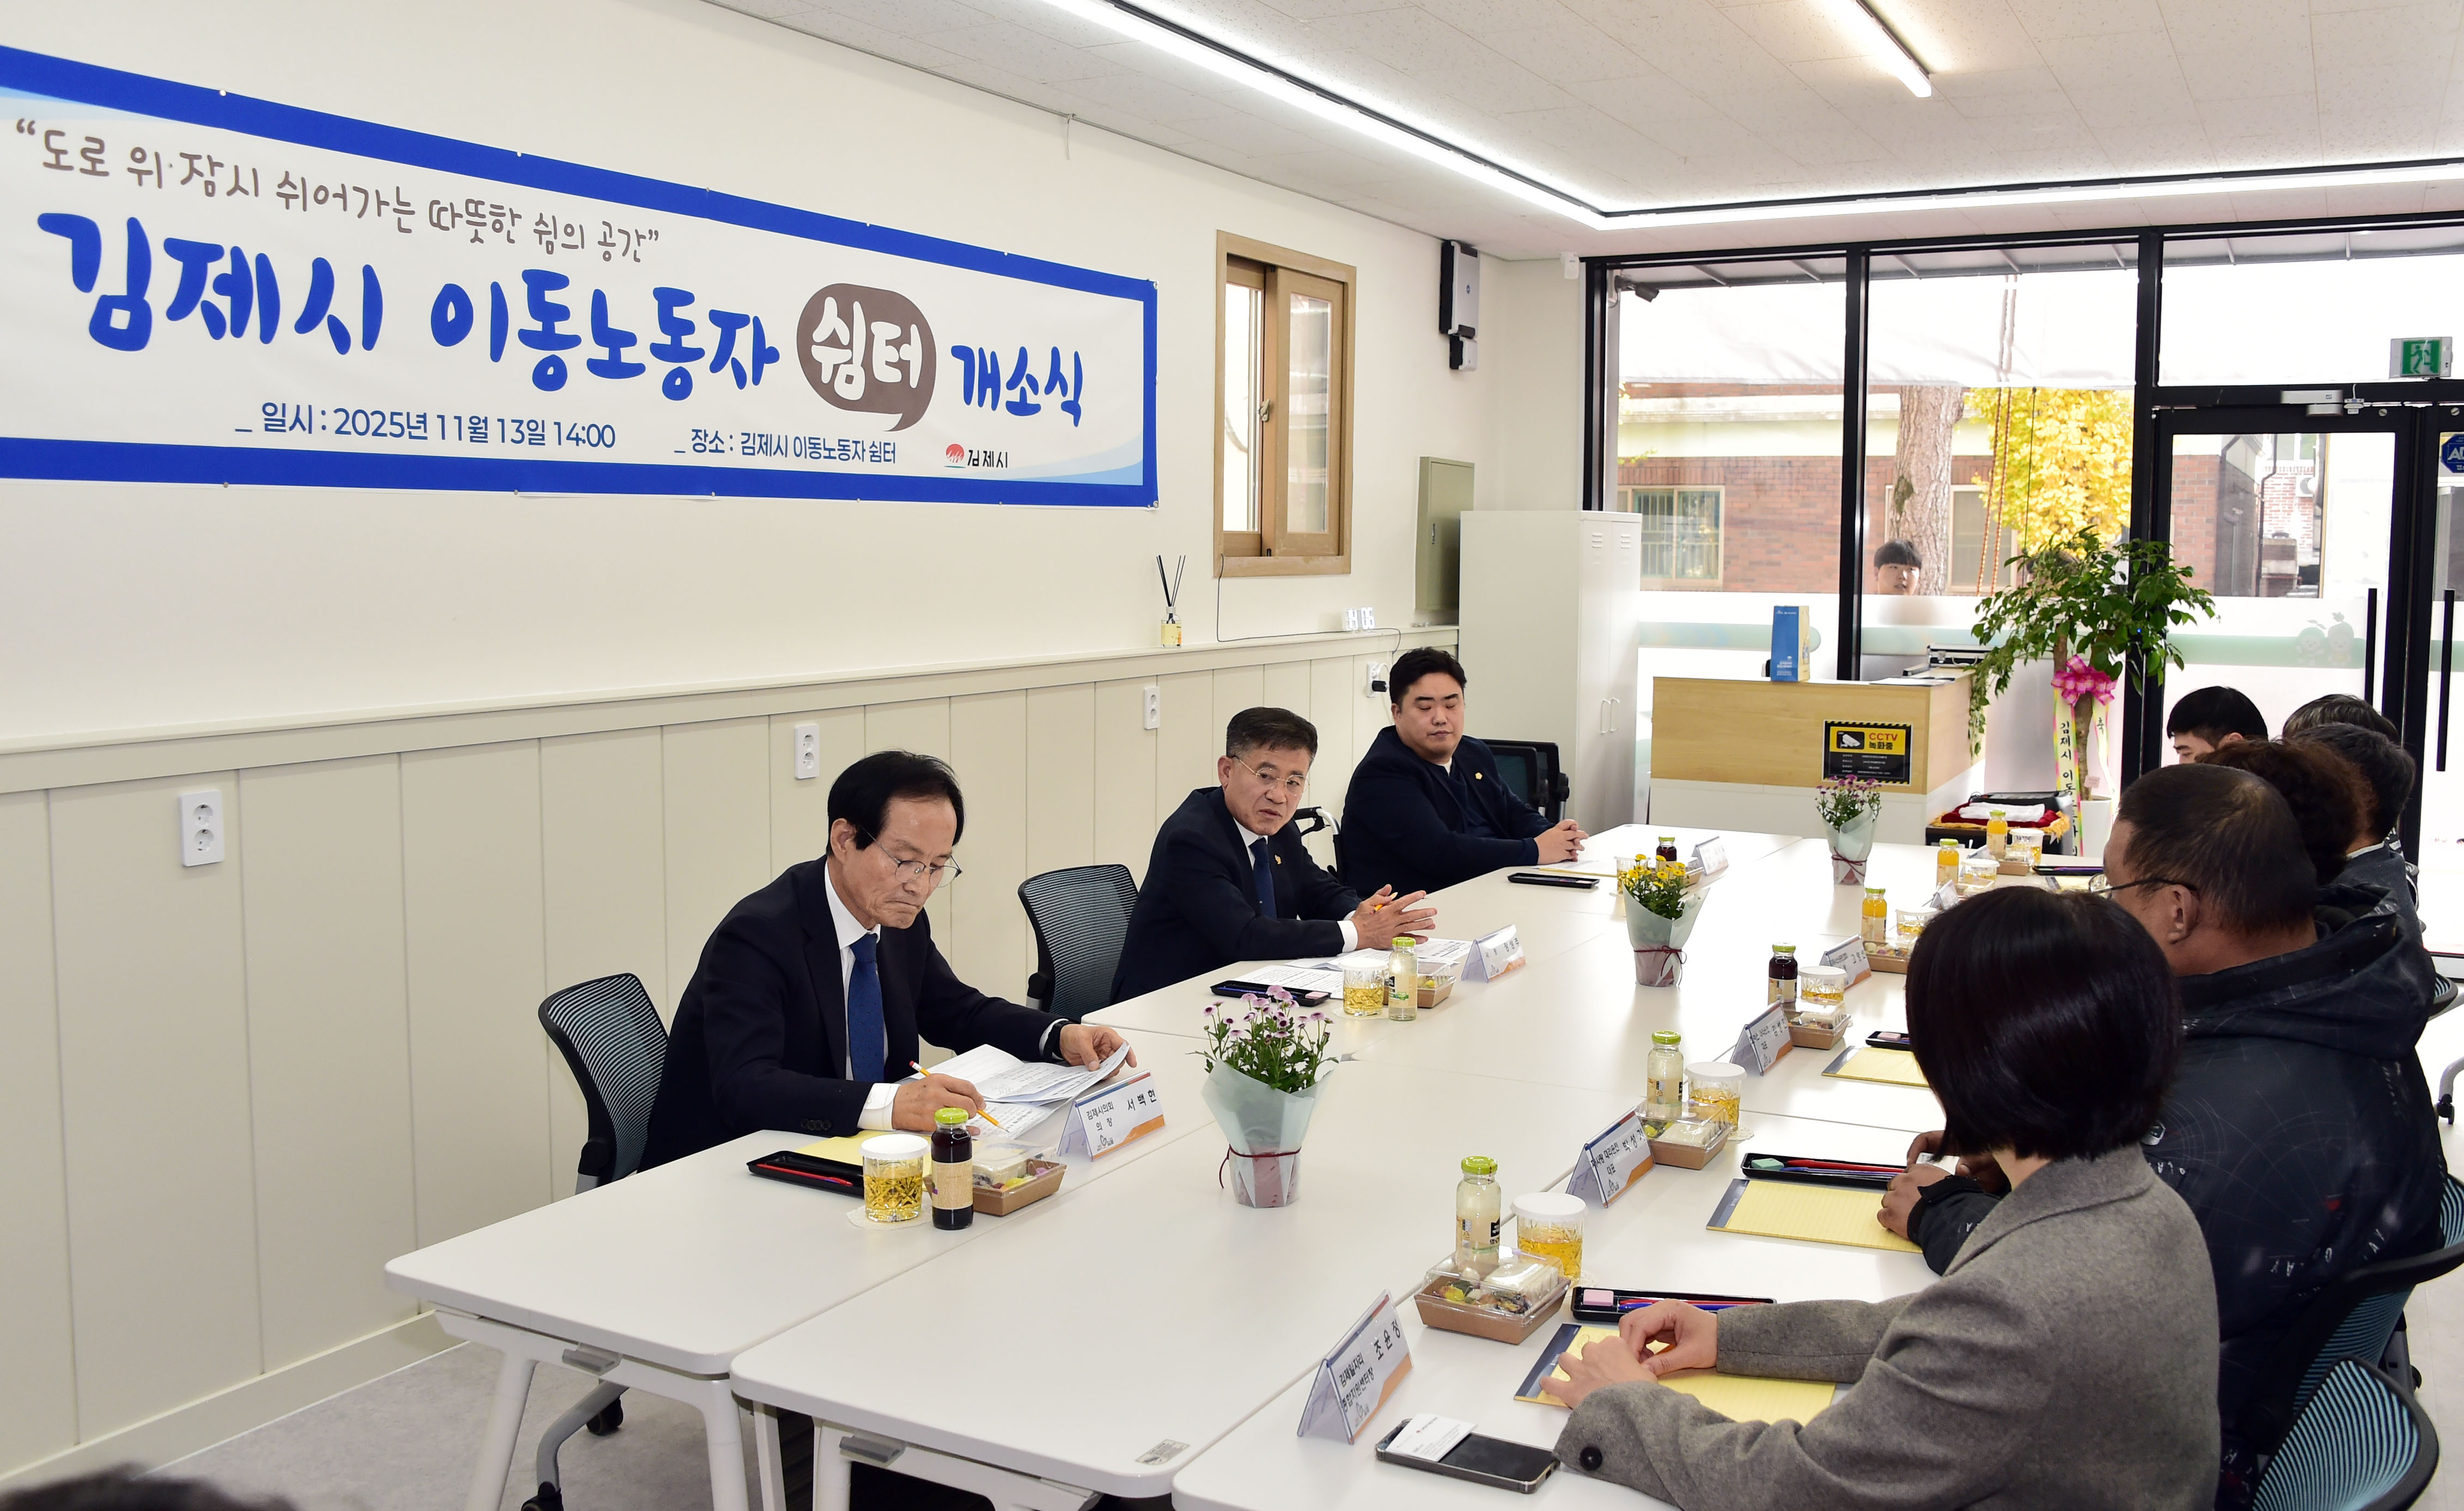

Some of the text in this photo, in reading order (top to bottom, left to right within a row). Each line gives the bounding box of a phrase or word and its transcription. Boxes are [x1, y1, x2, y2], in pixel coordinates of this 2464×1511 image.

[180, 152, 259, 198] 잠시
[276, 170, 416, 234] 쉬어가는
[429, 199, 522, 244] 따뜻한
[533, 212, 584, 255] 쉼의
[38, 213, 1083, 427] 김제시 이동노동자 쉼터 개소식
[333, 407, 428, 440] 2025년
[436, 414, 489, 444] 11월
[497, 418, 546, 446] 13일
[553, 421, 615, 448] 14:00
[741, 432, 788, 458] 김제시
[793, 436, 866, 462] 이동노동자
[869, 441, 896, 464] 쉼터
[967, 449, 1008, 468] 김제시
[1869, 733, 1898, 741] CCTV
[2060, 721, 2072, 761] 김제시
[1086, 1101, 1114, 1121] 김제시의회
[1606, 1163, 1616, 1176] 대표
[1339, 1352, 1365, 1387] 김제일자리
